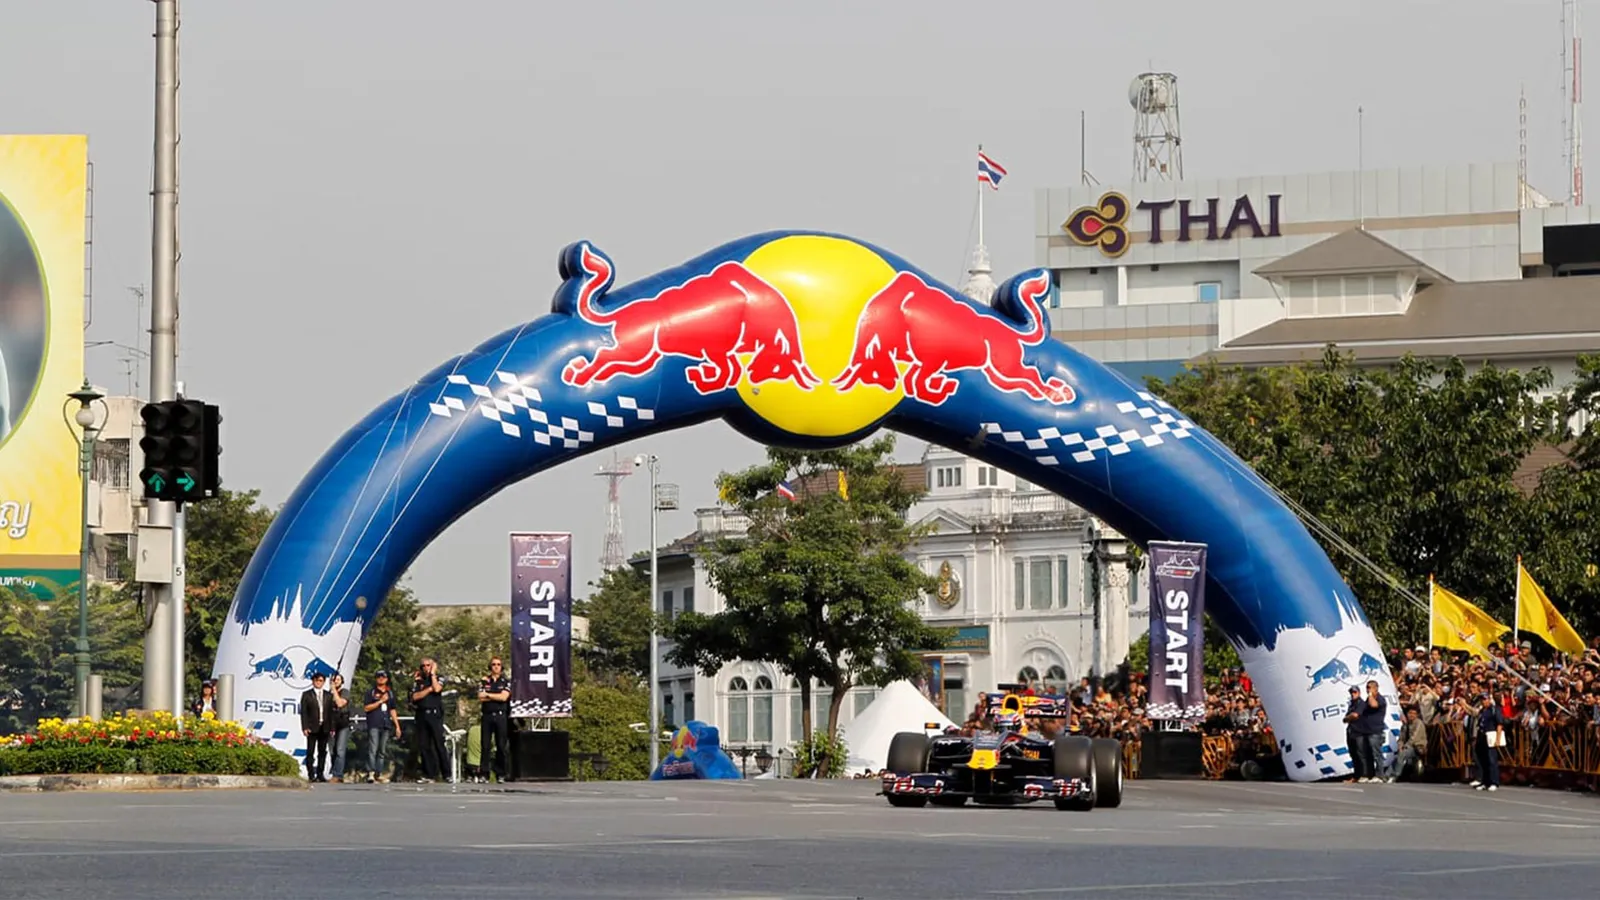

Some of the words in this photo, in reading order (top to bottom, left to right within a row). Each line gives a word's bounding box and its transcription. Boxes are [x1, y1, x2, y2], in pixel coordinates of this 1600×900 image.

[1136, 194, 1282, 244] THAI
[175, 566, 183, 577] 5
[529, 580, 556, 688] START
[1165, 589, 1189, 694] START
